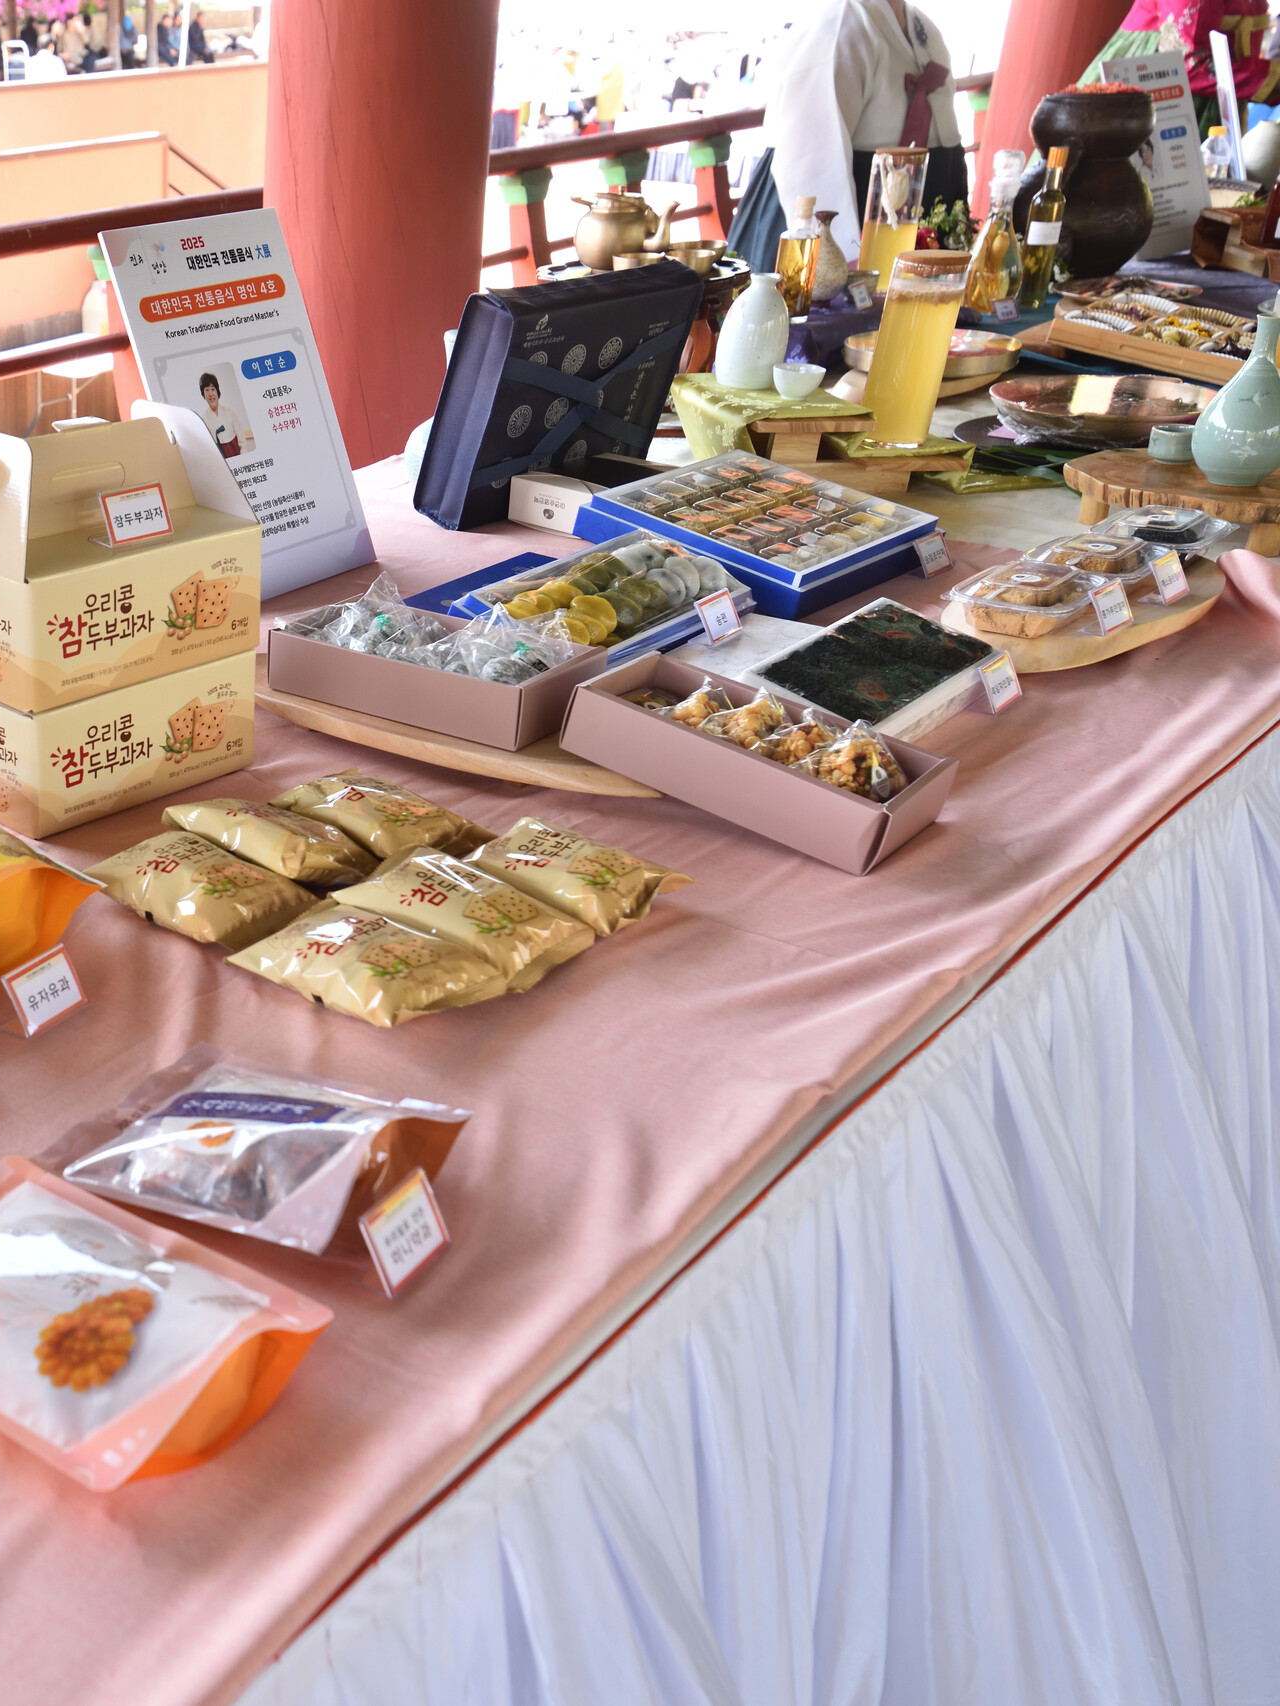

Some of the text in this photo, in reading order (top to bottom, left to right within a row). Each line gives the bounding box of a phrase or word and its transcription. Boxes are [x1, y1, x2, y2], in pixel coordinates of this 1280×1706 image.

[180, 235, 205, 251] 2025
[186, 243, 273, 271] 대한민국 전통음식 大展
[150, 279, 278, 317] 대한민국 전통음식 명인 4호
[165, 308, 280, 341] Korean Traditional Food Grand Master's
[252, 474, 267, 484] 제52호
[114, 507, 163, 528] 참두부과자
[83, 584, 135, 620] 우리콩
[231, 616, 249, 630] 6개입
[85, 713, 134, 750] 우리콩
[226, 737, 243, 751] 6개입
[28, 977, 71, 1011] 유자유과
